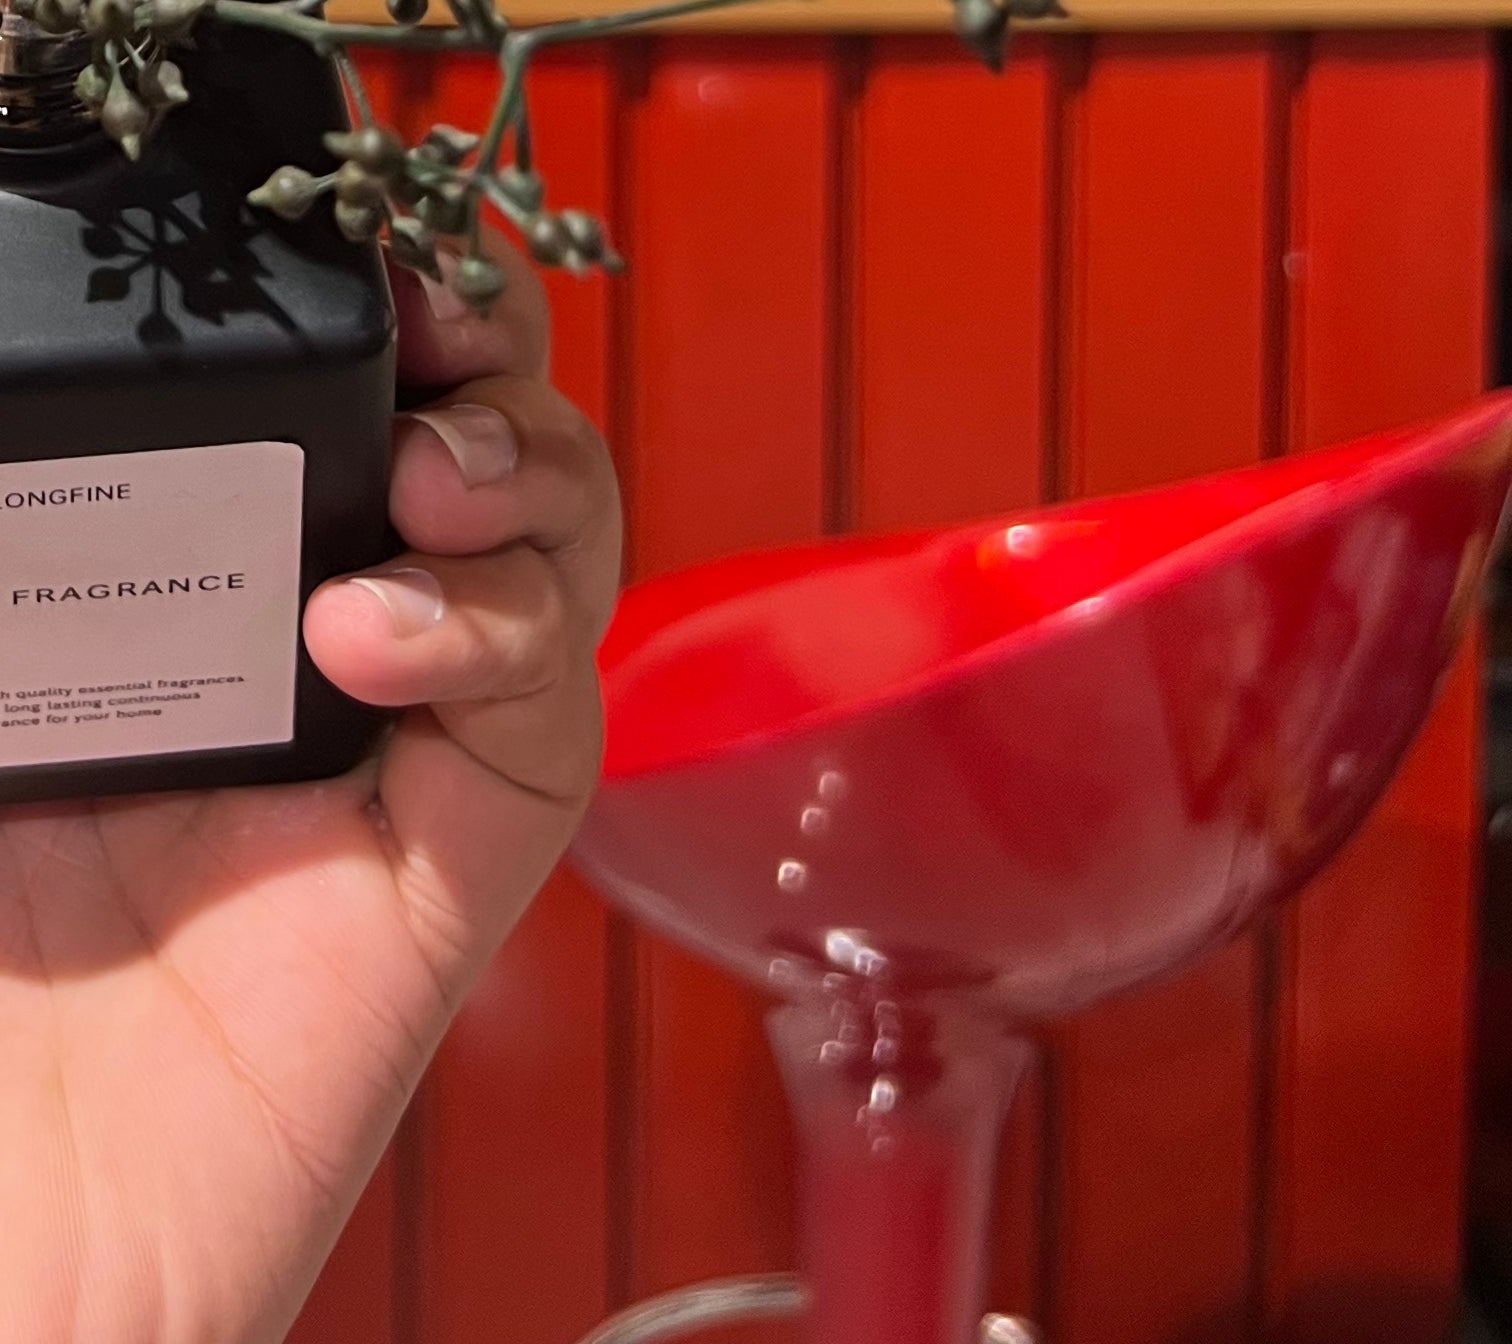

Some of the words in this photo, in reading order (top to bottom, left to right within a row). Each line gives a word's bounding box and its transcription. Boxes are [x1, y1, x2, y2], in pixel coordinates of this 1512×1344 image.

[12, 572, 246, 606] FRAGRANCE
[16, 687, 73, 700] quality
[78, 680, 152, 695] essential
[157, 676, 245, 689] fragrances
[4, 703, 41, 714] long
[47, 699, 102, 710] lasting
[107, 692, 201, 706] continuous
[46, 714, 69, 724] for
[74, 713, 110, 724] your
[116, 708, 162, 719] home
